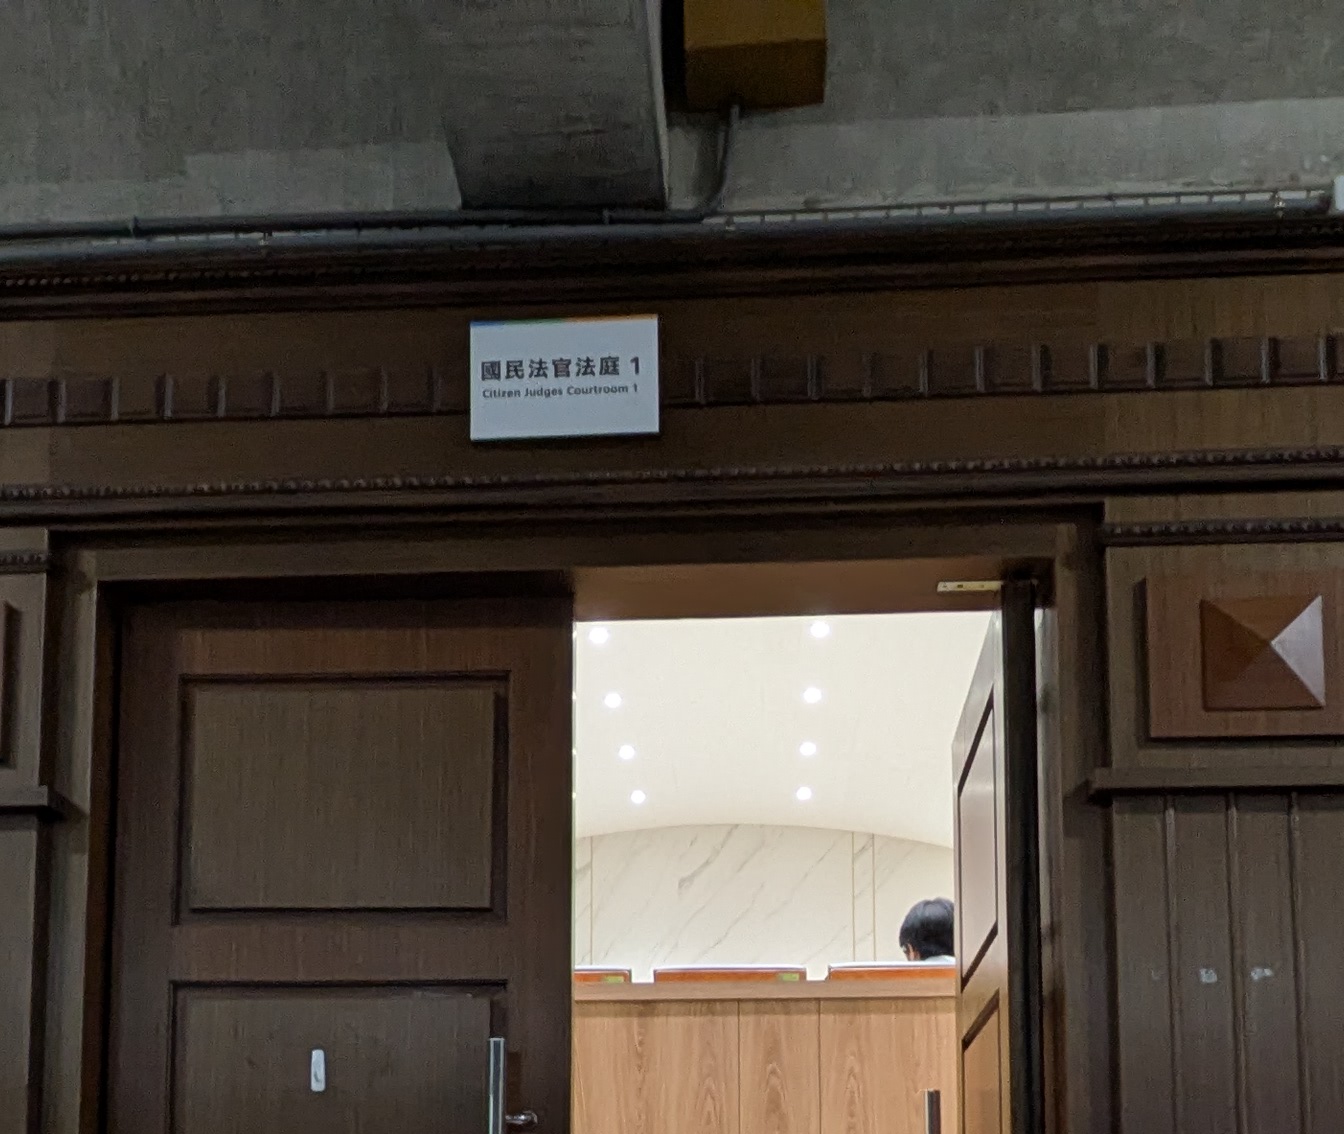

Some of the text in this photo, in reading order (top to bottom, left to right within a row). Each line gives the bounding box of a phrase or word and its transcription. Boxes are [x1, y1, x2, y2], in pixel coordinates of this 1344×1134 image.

[481, 356, 641, 381] 國民法官法庭 1
[482, 383, 638, 398] Citizen Judges Courtroom 1
